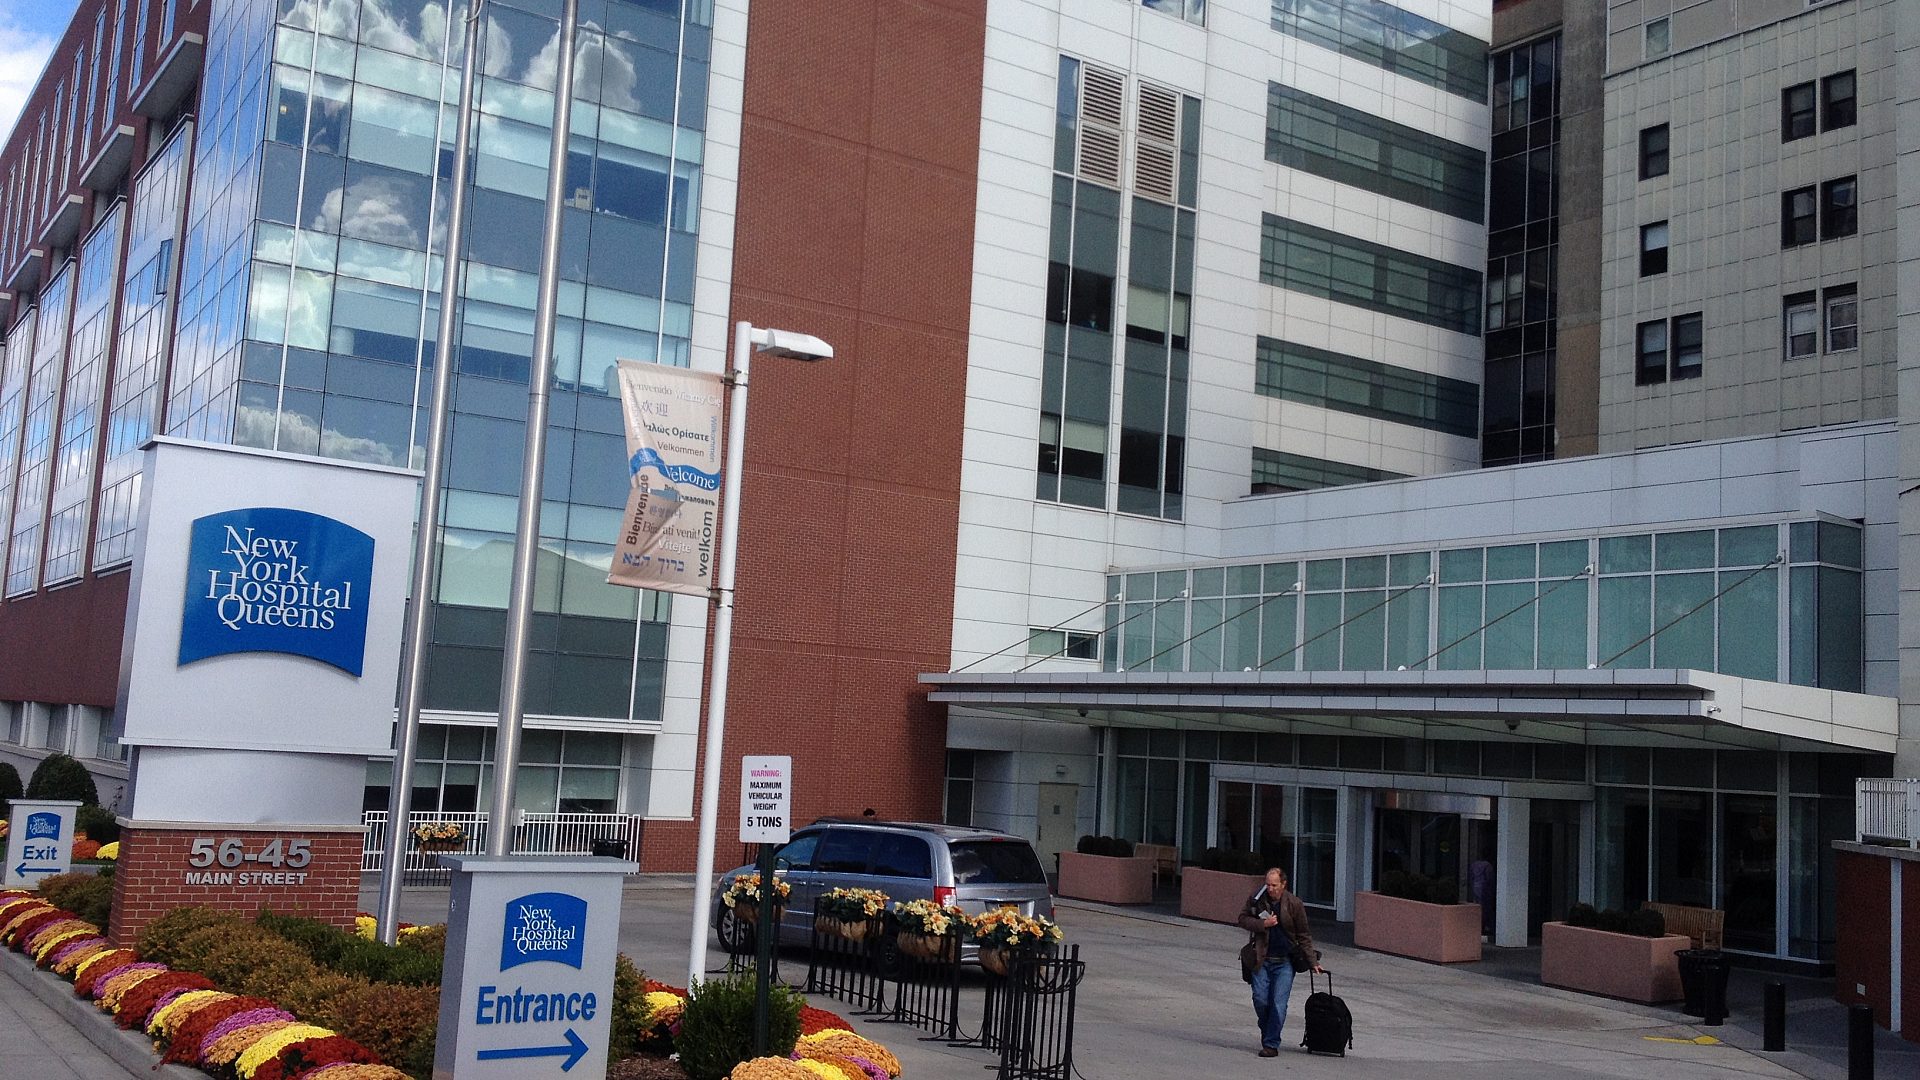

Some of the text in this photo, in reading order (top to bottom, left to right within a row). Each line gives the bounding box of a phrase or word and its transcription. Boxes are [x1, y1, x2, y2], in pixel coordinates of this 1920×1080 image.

[657, 441, 705, 457] Velkommen
[221, 525, 298, 559] New
[659, 538, 692, 555] Vitejte
[698, 511, 713, 577] welkom
[231, 549, 309, 585] York
[658, 557, 685, 574] ברוך
[205, 569, 351, 611] Hospital
[217, 593, 335, 630] Queens
[751, 769, 782, 777] WARNING:
[749, 781, 782, 789] MAXIMUM
[748, 792, 783, 800] VEHICULAR
[747, 816, 782, 827] 5 TONS
[22, 845, 58, 860] Exit
[189, 838, 312, 868] 56-45
[185, 872, 308, 885] MAIN STREET
[518, 904, 551, 919] New
[523, 916, 557, 931] York
[512, 926, 576, 943] Hospital
[516, 937, 568, 955] Queens
[476, 985, 597, 1025] Entrance
